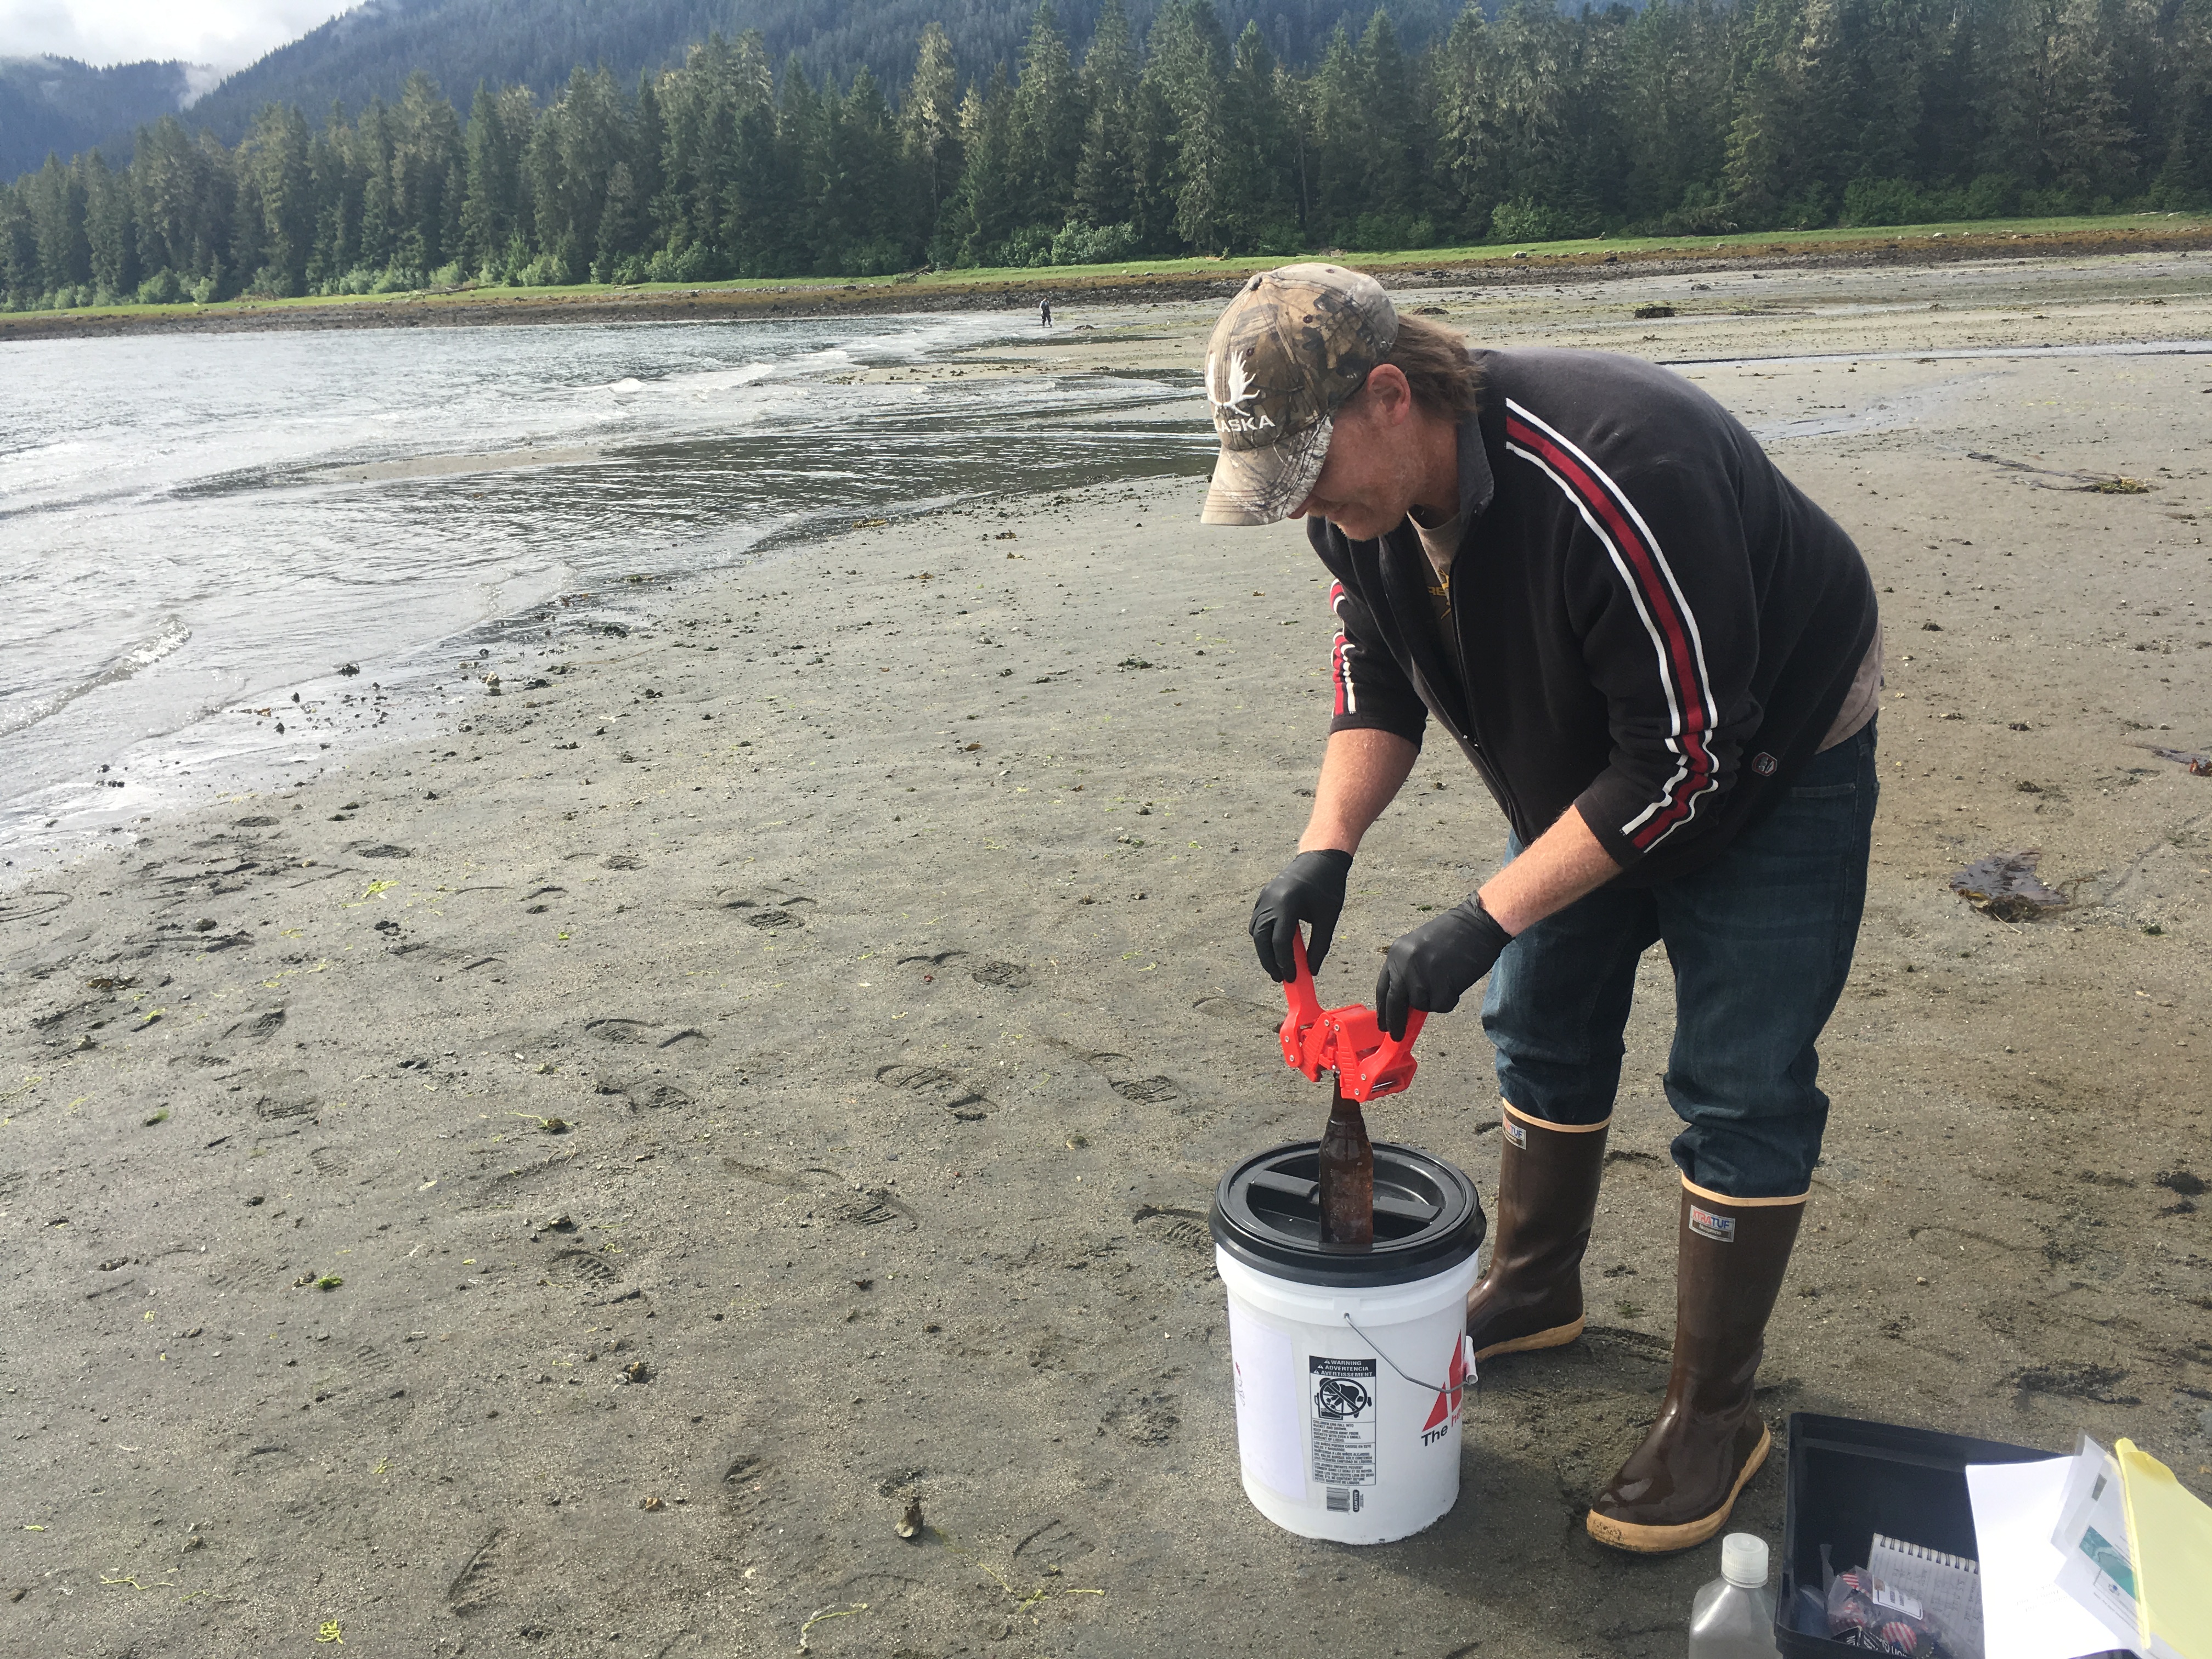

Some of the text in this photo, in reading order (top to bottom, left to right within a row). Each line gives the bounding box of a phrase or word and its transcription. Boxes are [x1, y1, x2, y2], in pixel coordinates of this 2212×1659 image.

[1212, 415, 1276, 433] LASKA
[1692, 1209, 1730, 1229] XTRATUF
[1421, 1425, 1448, 1447] The
